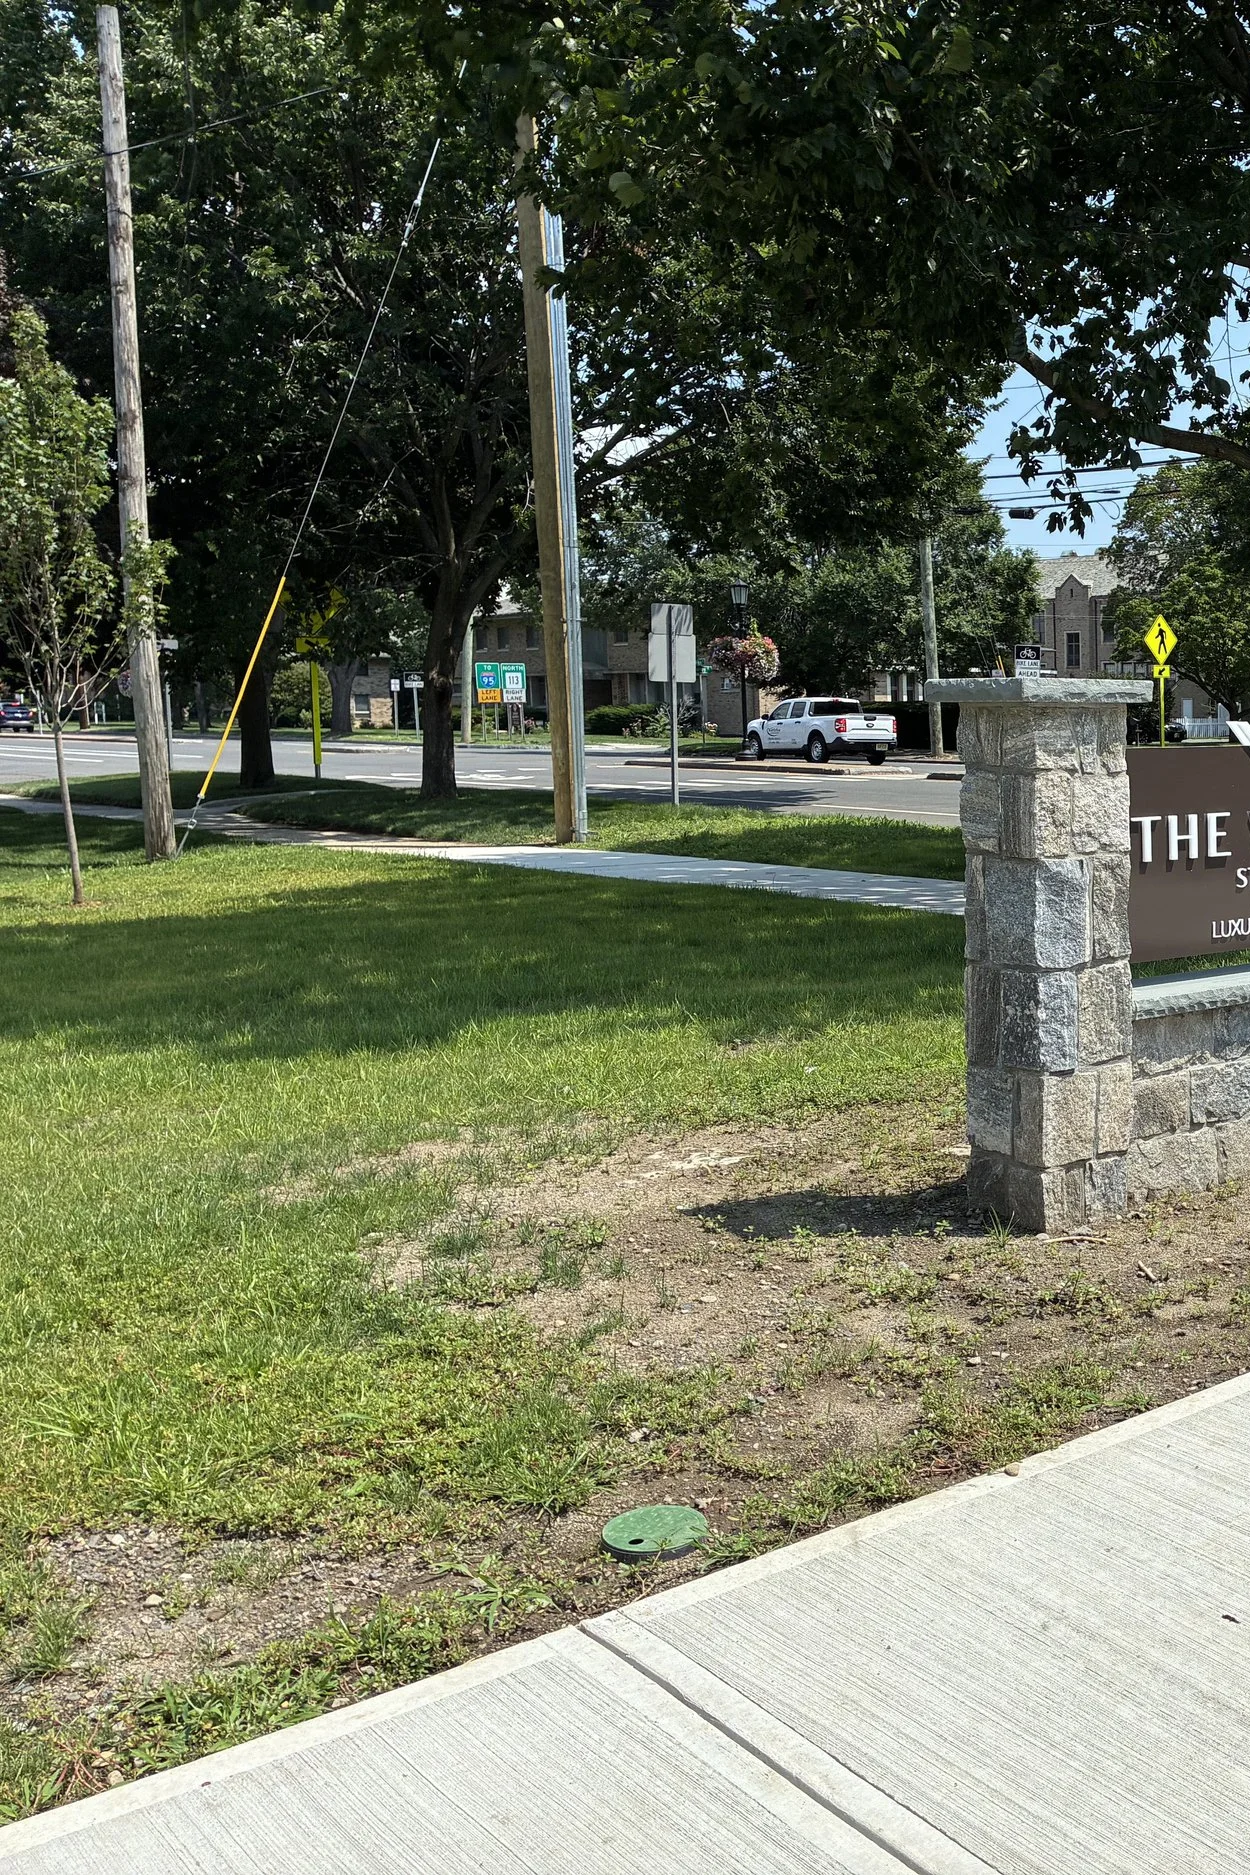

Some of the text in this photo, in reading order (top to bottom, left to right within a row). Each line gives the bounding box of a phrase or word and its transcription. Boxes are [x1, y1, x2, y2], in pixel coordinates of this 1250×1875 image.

[482, 676, 494, 685] 95
[508, 676, 520, 685] 113
[1131, 811, 1232, 862] THE
